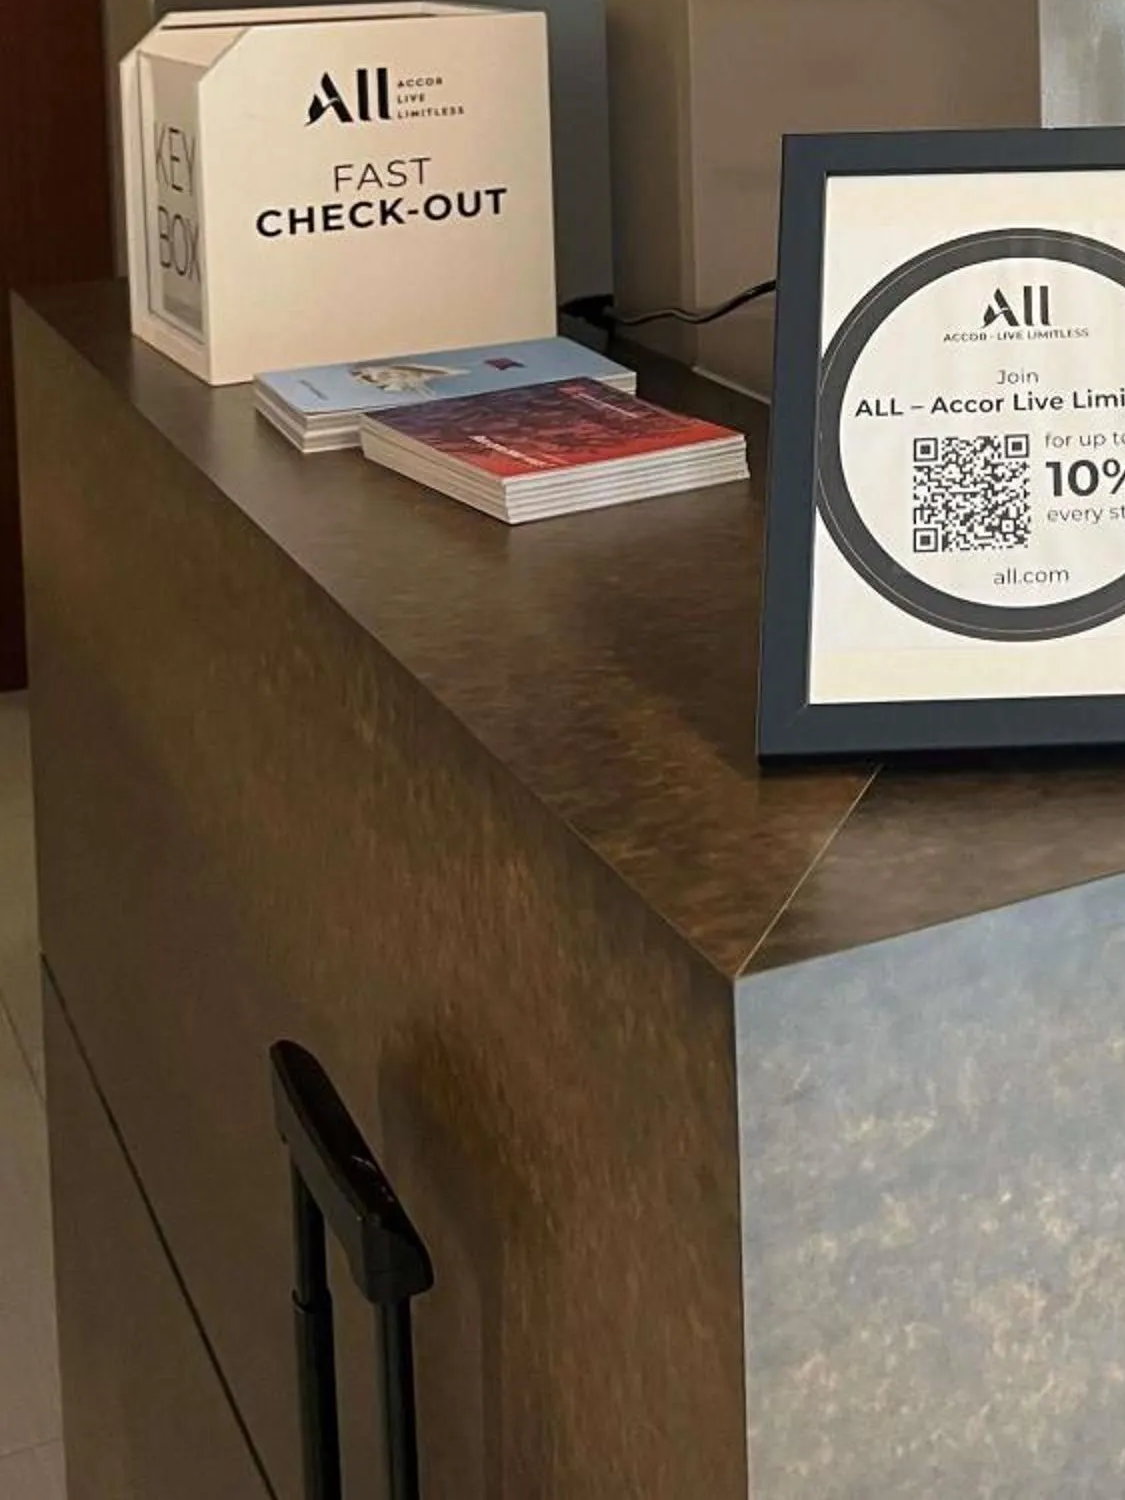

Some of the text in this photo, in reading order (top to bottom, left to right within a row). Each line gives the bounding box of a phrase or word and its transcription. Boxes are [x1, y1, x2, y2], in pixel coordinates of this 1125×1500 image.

[397, 77, 443, 88] ACCOR
[397, 93, 425, 104] LIVE
[397, 106, 464, 119] LIMITLESS
[154, 123, 196, 196] KEY
[333, 156, 431, 193] FAST
[256, 188, 507, 238] CHECK-OUT
[158, 205, 201, 283] BOX
[943, 331, 987, 343] ACCOR
[997, 331, 1024, 342] LIVE
[1027, 327, 1090, 340] LIMITLESS
[997, 368, 1040, 386] Join
[855, 397, 904, 418] ALL
[930, 395, 1004, 414] Accor
[1013, 391, 1064, 412] Live
[1045, 431, 1072, 449] for
[1079, 433, 1107, 450] up
[1047, 508, 1103, 525] every
[993, 565, 1070, 587] all.com
